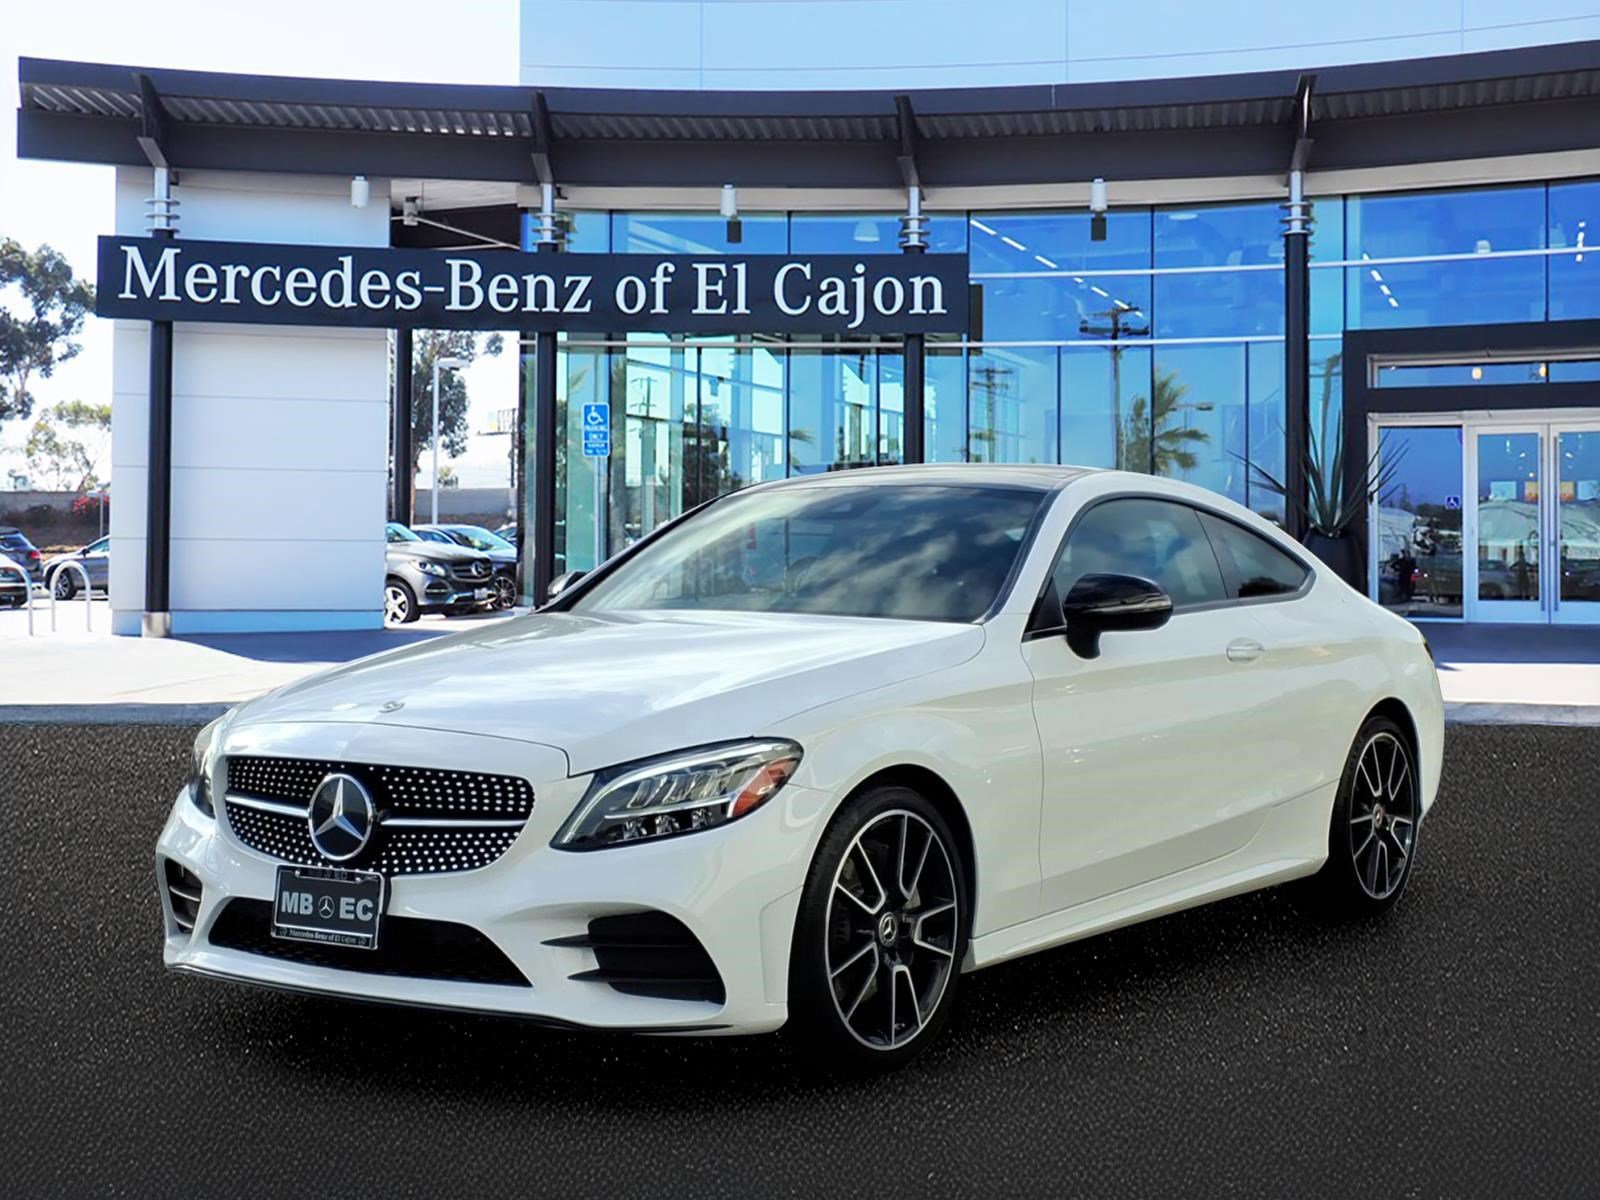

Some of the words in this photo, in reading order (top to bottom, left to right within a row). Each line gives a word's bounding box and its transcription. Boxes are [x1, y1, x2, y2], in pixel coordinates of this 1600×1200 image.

[117, 245, 592, 314] Mercedes-Benz
[615, 262, 676, 315] of
[692, 262, 751, 315] El
[773, 262, 947, 329] Cajon
[281, 891, 313, 915] MB
[339, 897, 373, 921] EC
